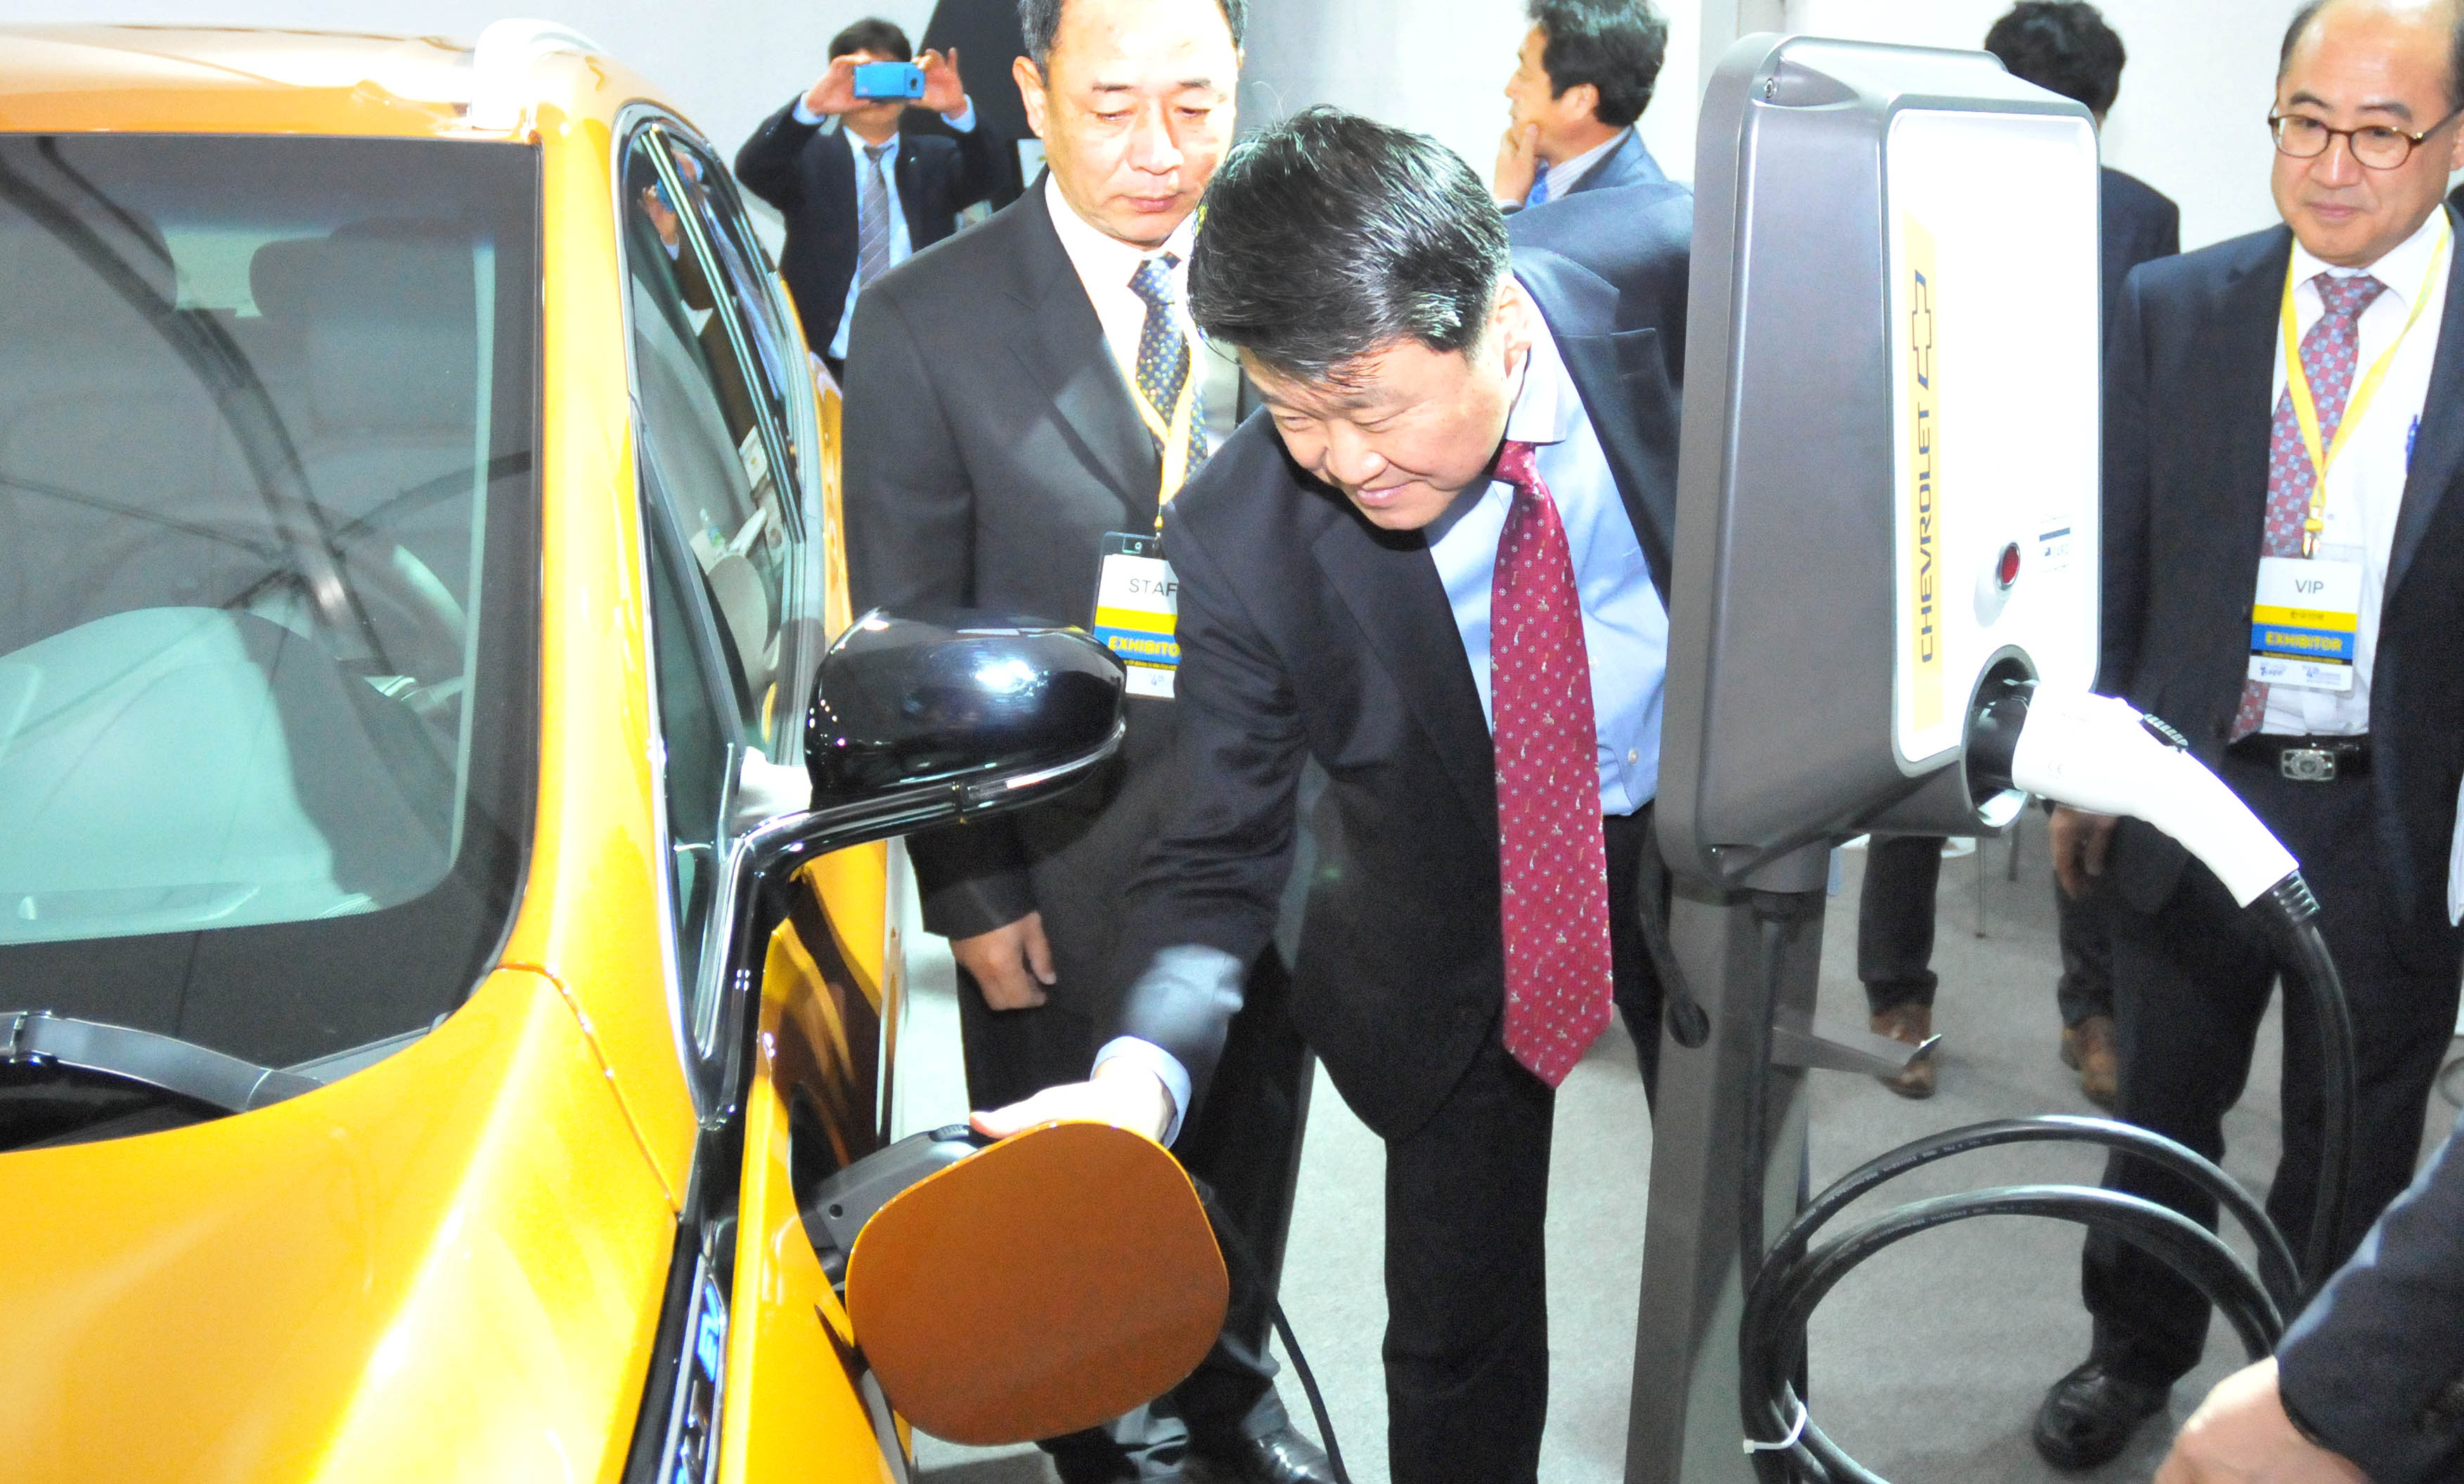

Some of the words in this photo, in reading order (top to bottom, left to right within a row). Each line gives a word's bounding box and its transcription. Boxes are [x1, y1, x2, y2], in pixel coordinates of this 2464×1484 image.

[1916, 401, 1933, 663] CHEVROLET
[1128, 578, 1178, 597] STAF
[2295, 579, 2324, 593] VIP
[1108, 635, 1180, 657] EXHIBITO
[2266, 632, 2343, 651] EXHIBITOR
